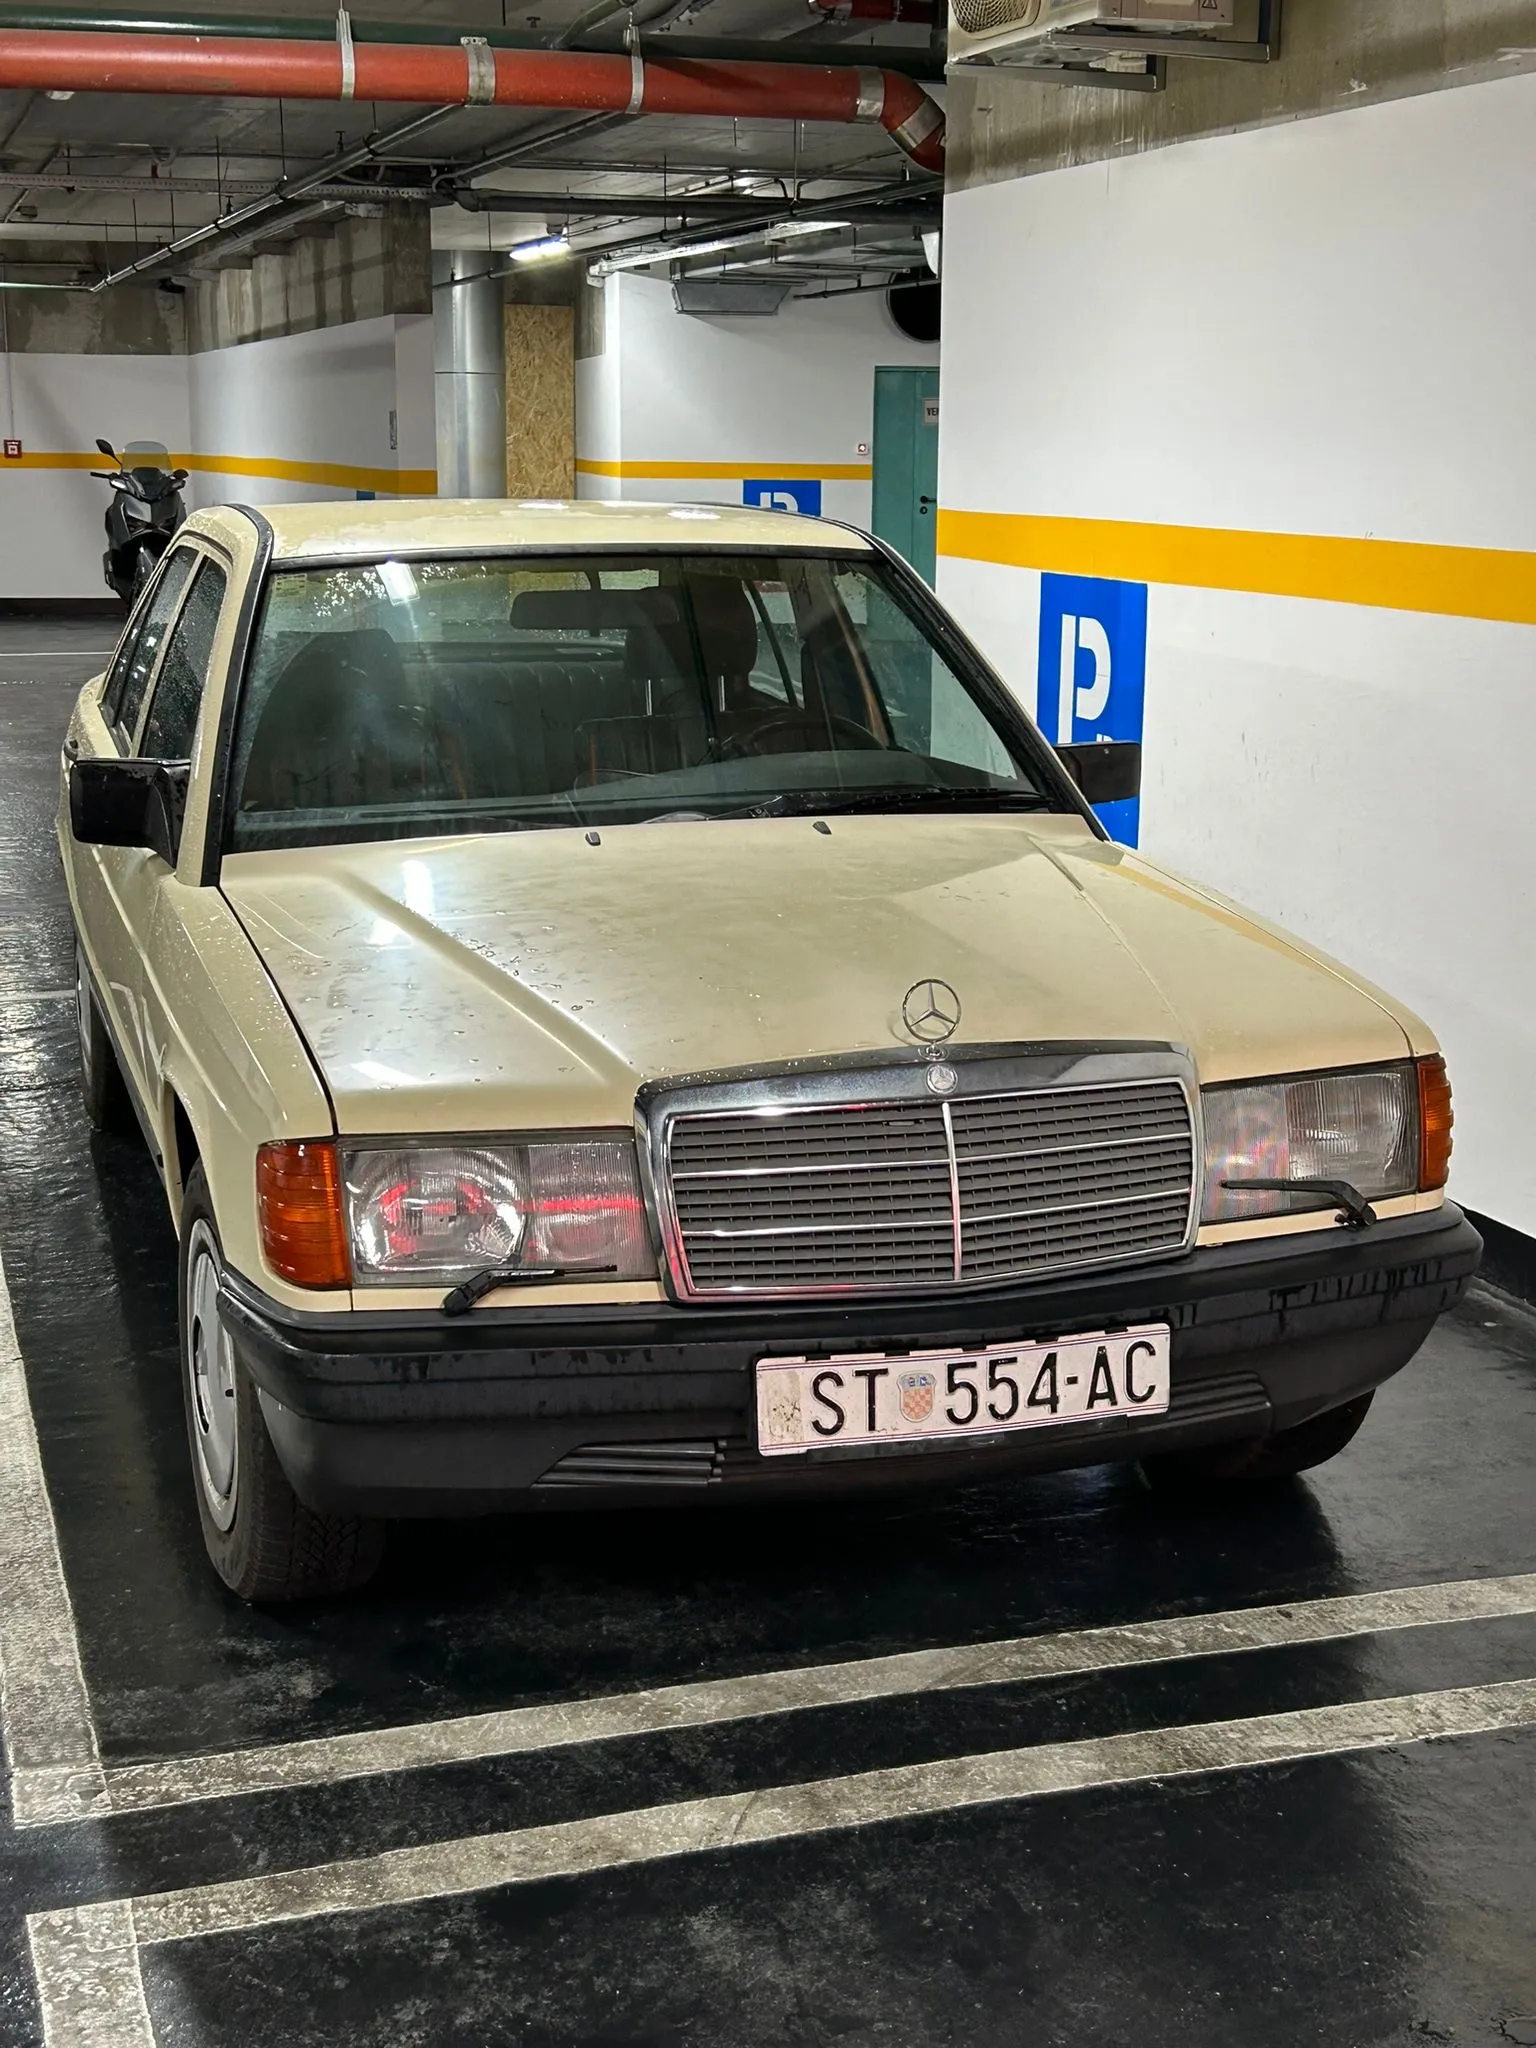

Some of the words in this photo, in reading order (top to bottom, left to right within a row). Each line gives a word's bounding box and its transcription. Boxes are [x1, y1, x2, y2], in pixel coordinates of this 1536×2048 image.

[1058, 613, 1111, 744] P
[811, 1368, 889, 1436] ST
[946, 1340, 1157, 1425] 554-AC
